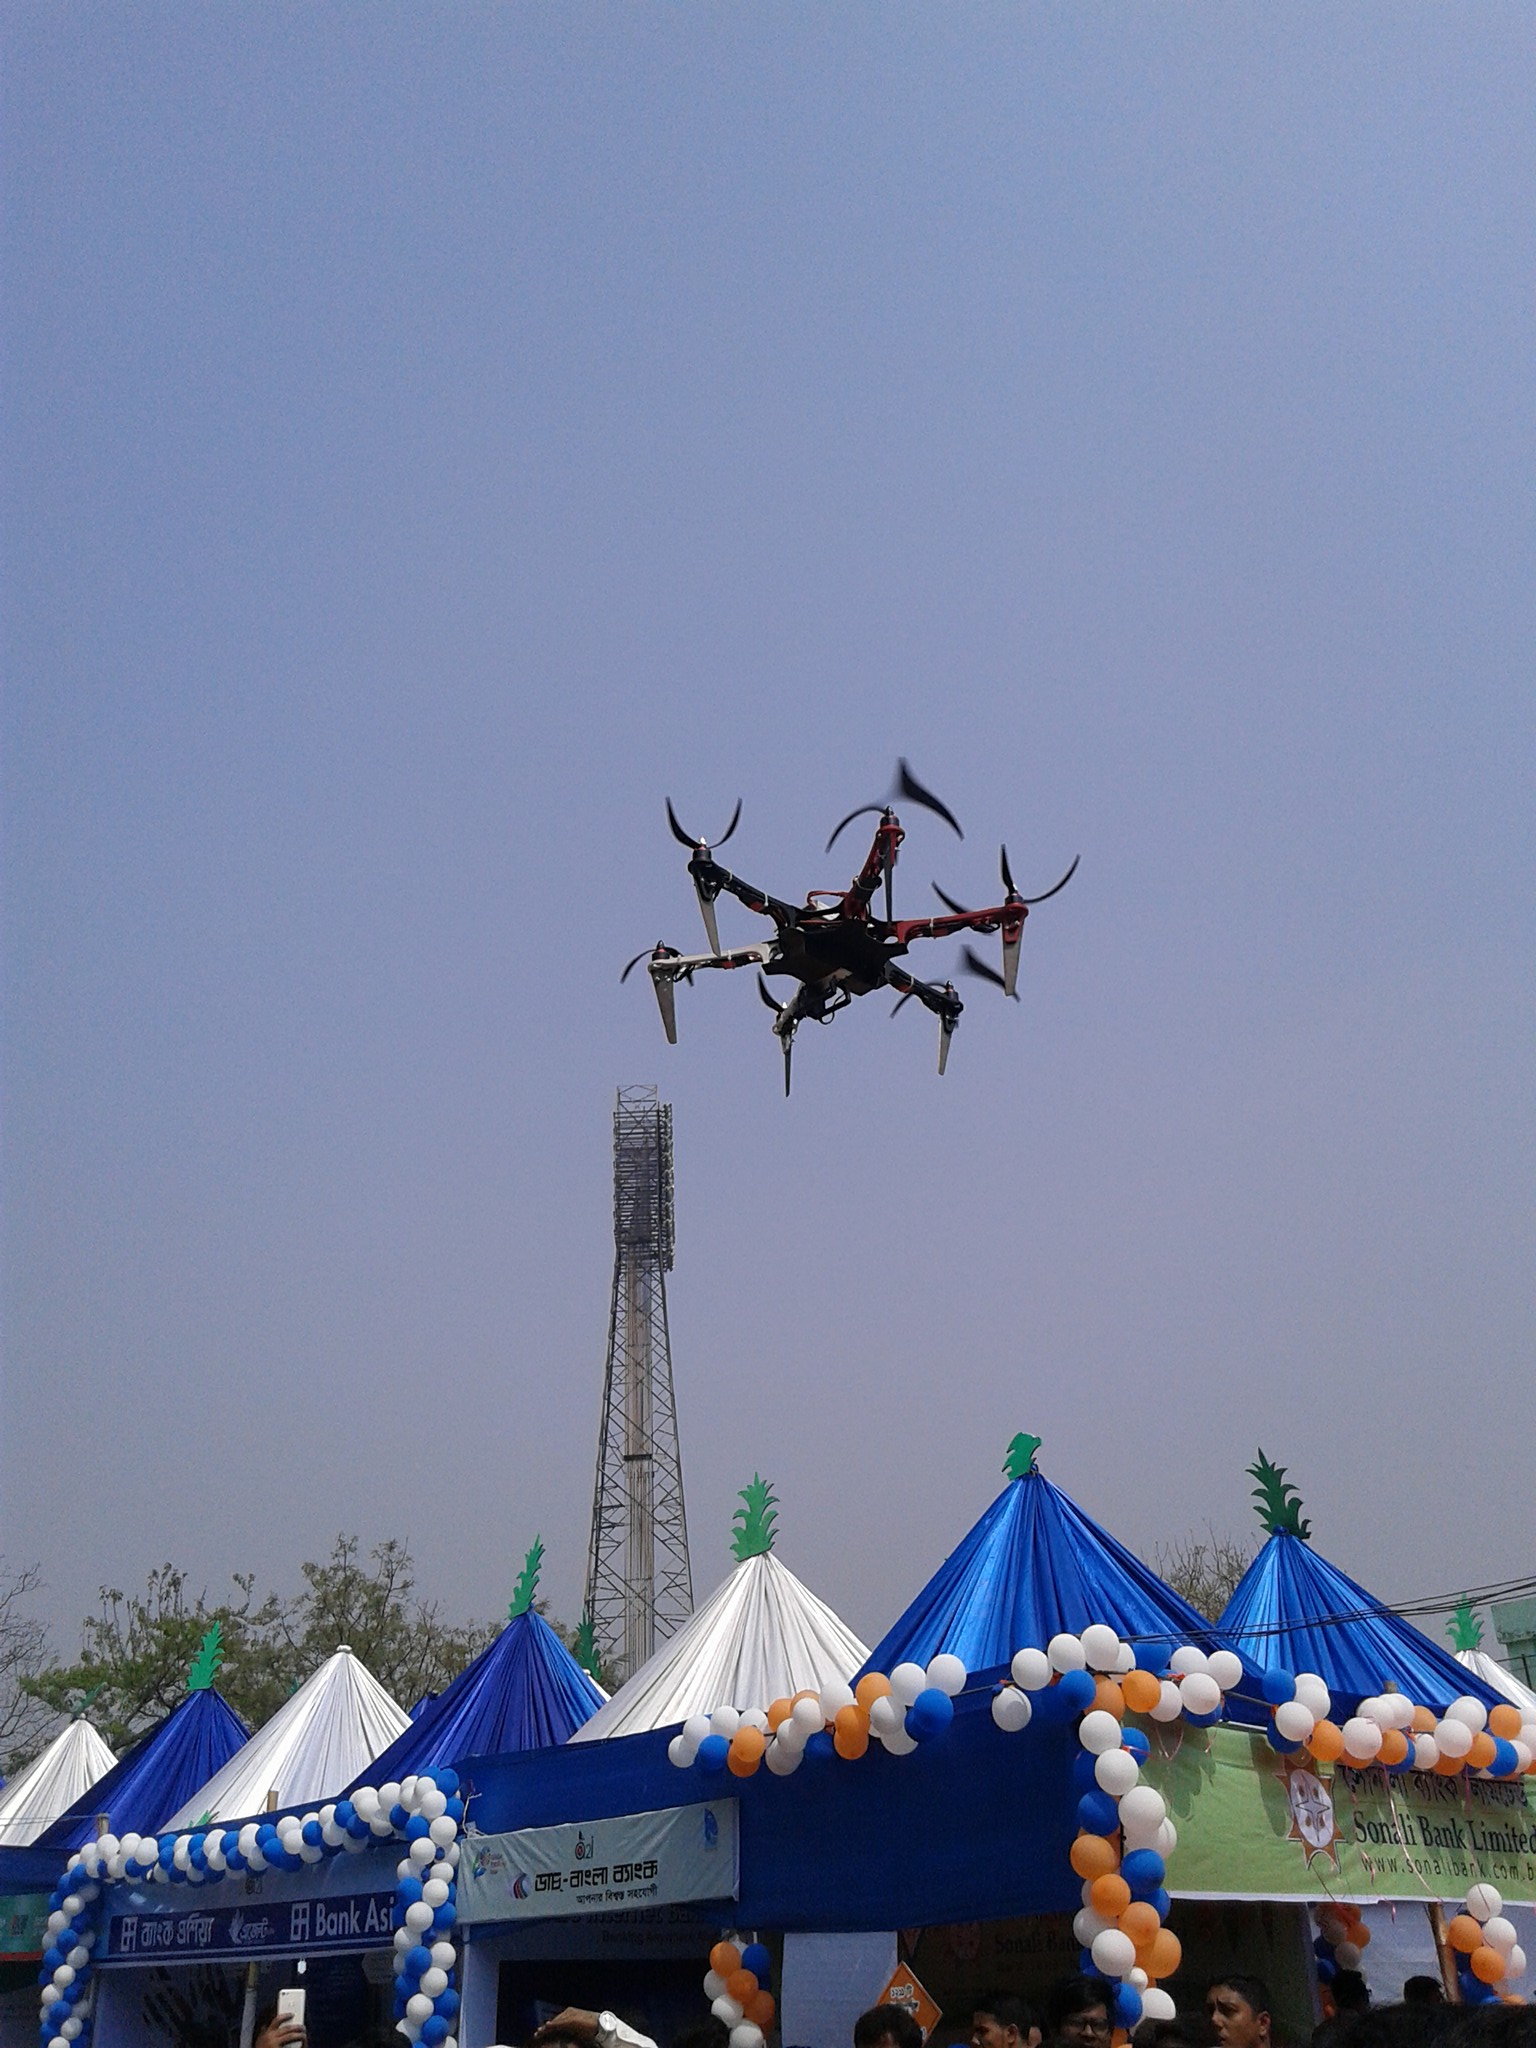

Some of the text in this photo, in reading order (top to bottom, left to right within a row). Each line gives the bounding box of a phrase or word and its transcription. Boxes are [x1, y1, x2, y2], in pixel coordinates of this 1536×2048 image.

[1353, 1811, 1536, 1855] Sonali Bank Limited
[612, 1859, 658, 1884] ব্যাংক
[1361, 1856, 1535, 1882] www.sonalibank.com.b
[315, 1896, 394, 1938] Bank Asi
[140, 1919, 175, 1947] ব্যাংক
